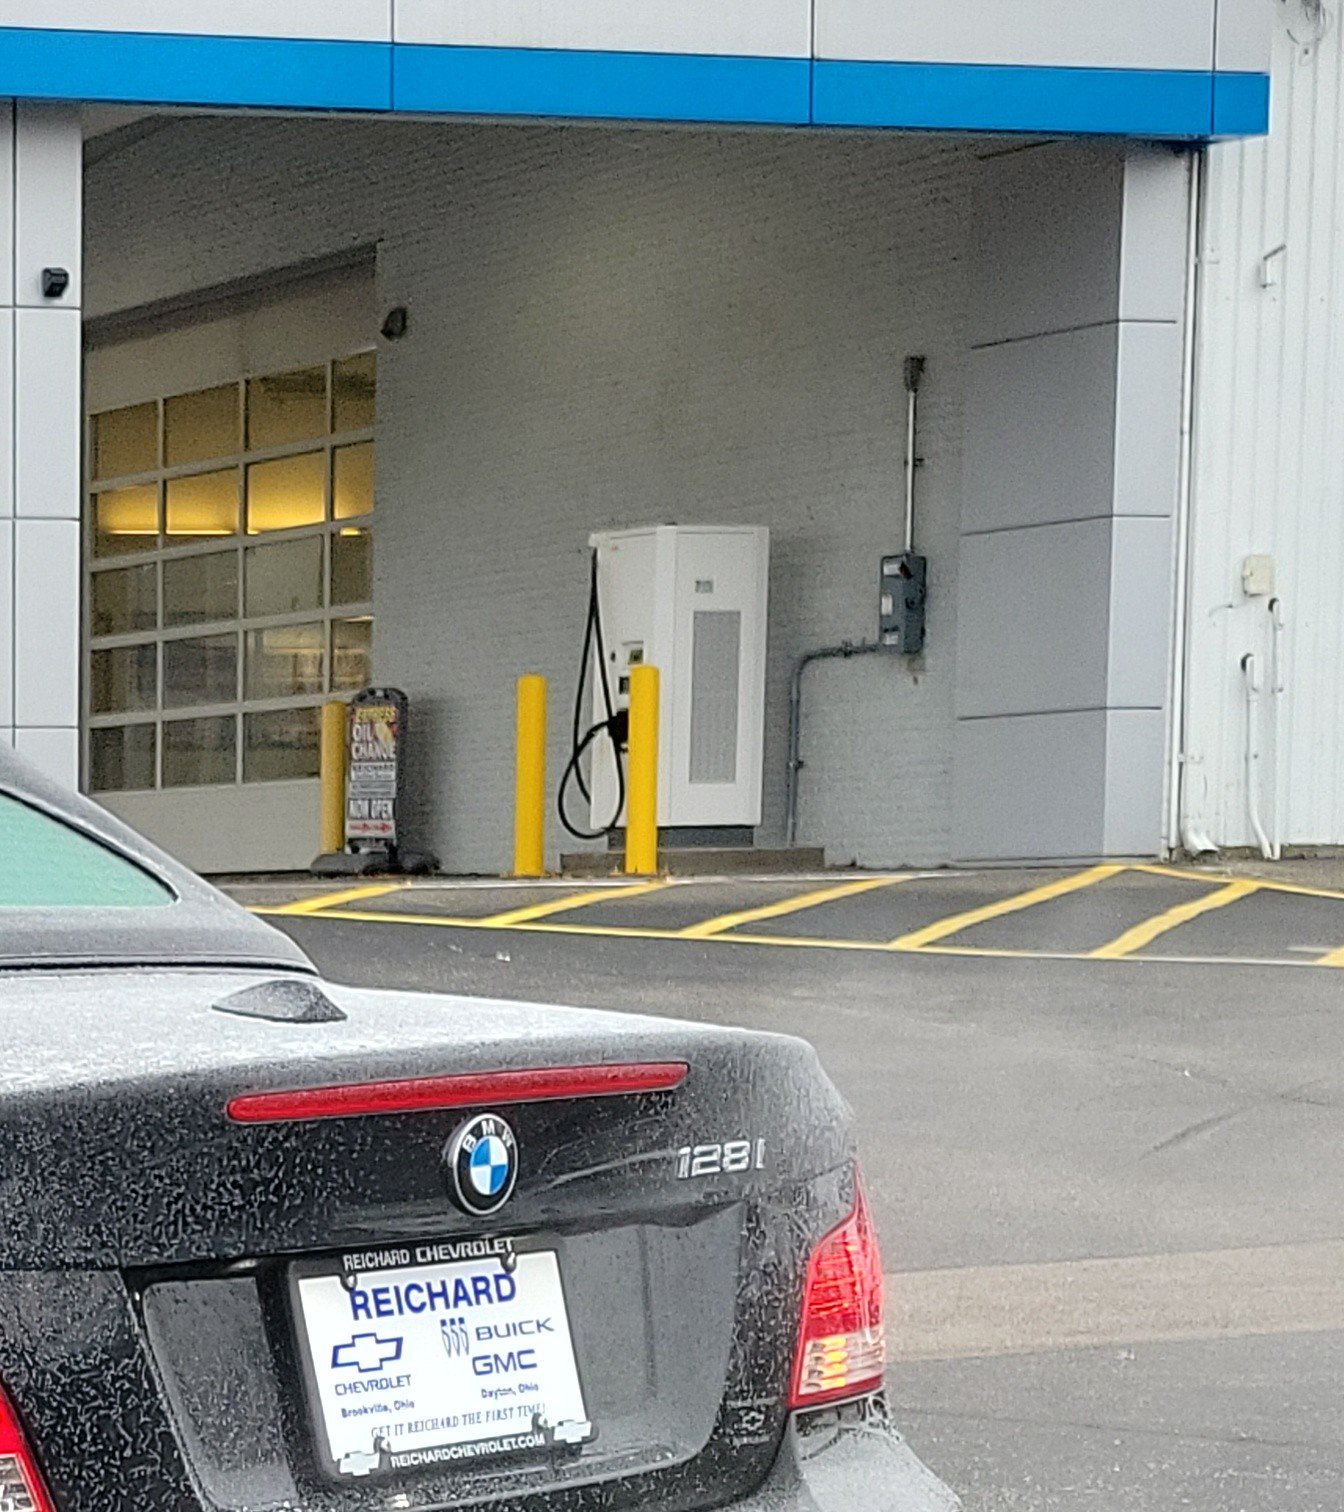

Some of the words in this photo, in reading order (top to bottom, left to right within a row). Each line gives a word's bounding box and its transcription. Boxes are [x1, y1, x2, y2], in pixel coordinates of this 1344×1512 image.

[462, 1117, 515, 1153] BMW
[342, 1249, 411, 1272] REICHARD
[414, 1237, 514, 1264] CHEVROLET
[348, 1272, 517, 1321] REICHARD
[475, 1317, 555, 1341] BUICK
[472, 1348, 538, 1376] GMC
[334, 1374, 412, 1396] CHEVROLET
[518, 1382, 540, 1394] Ohio
[393, 1399, 416, 1411] Ohio
[371, 1425, 391, 1438] GET
[394, 1423, 404, 1436] IT
[408, 1414, 459, 1434] REICHARD
[462, 1411, 482, 1426] THE
[485, 1407, 514, 1423] FIRST
[389, 1432, 547, 1469] REICHARDCHEVROLET.COM
